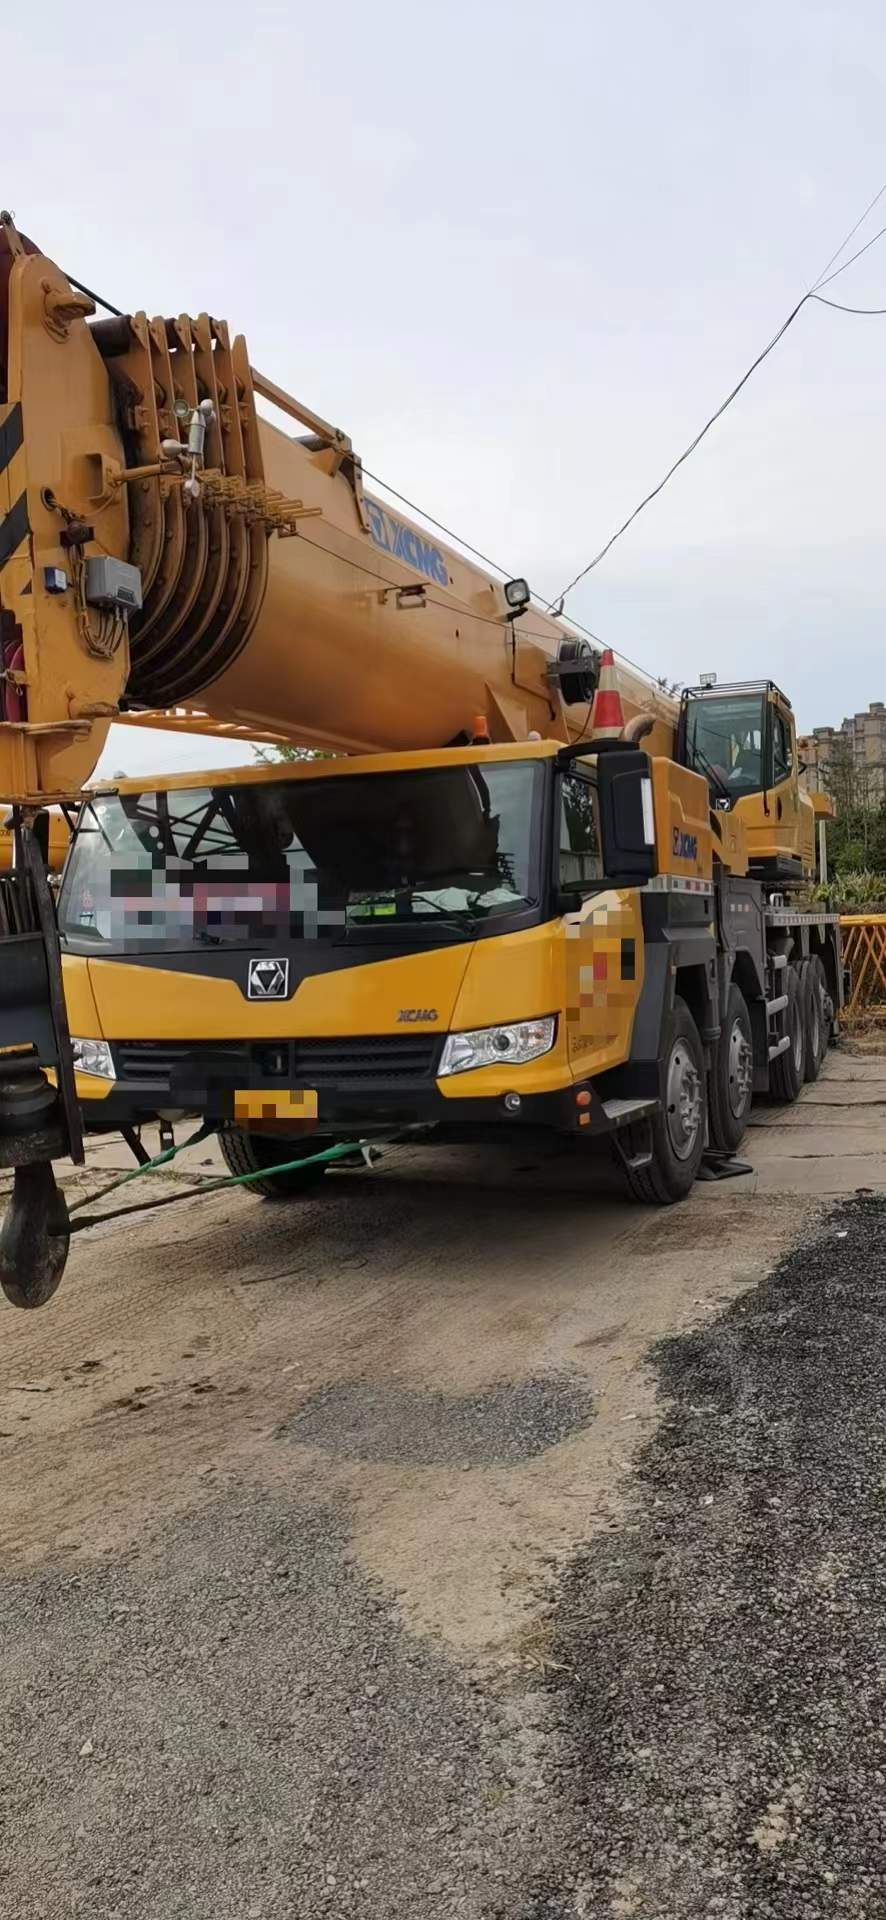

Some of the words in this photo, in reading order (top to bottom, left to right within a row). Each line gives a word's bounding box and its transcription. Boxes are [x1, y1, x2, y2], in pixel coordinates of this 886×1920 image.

[387, 516, 449, 587] XCMG
[680, 831, 697, 860] XCMG
[396, 1008, 438, 1022] XCMG
